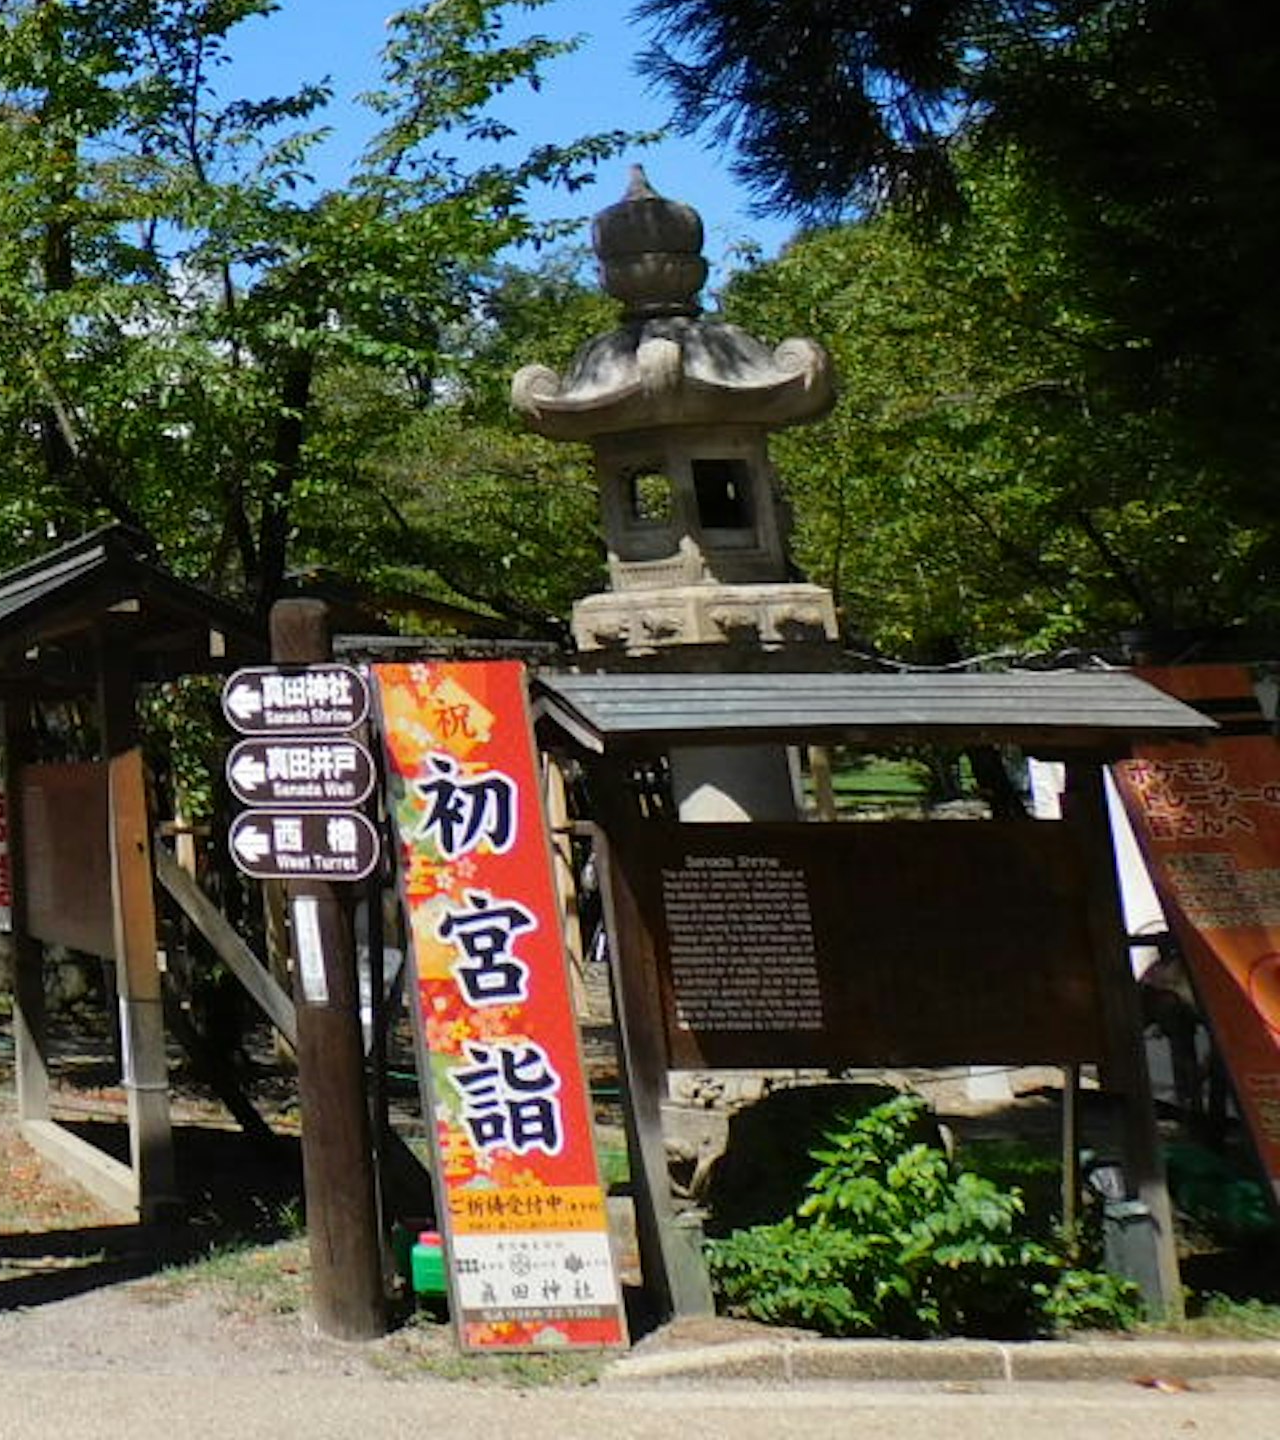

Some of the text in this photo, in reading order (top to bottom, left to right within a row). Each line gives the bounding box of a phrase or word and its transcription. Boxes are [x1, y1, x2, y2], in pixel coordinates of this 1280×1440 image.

[264, 709, 354, 725] Sanada Shrine
[435, 698, 478, 741] 祝
[1128, 762, 1226, 785] ポケモン
[273, 780, 356, 797] Sanada Well
[1148, 812, 1255, 840] 皆さんへ
[275, 854, 359, 872] West Turret
[418, 756, 562, 1155] 初宮詣
